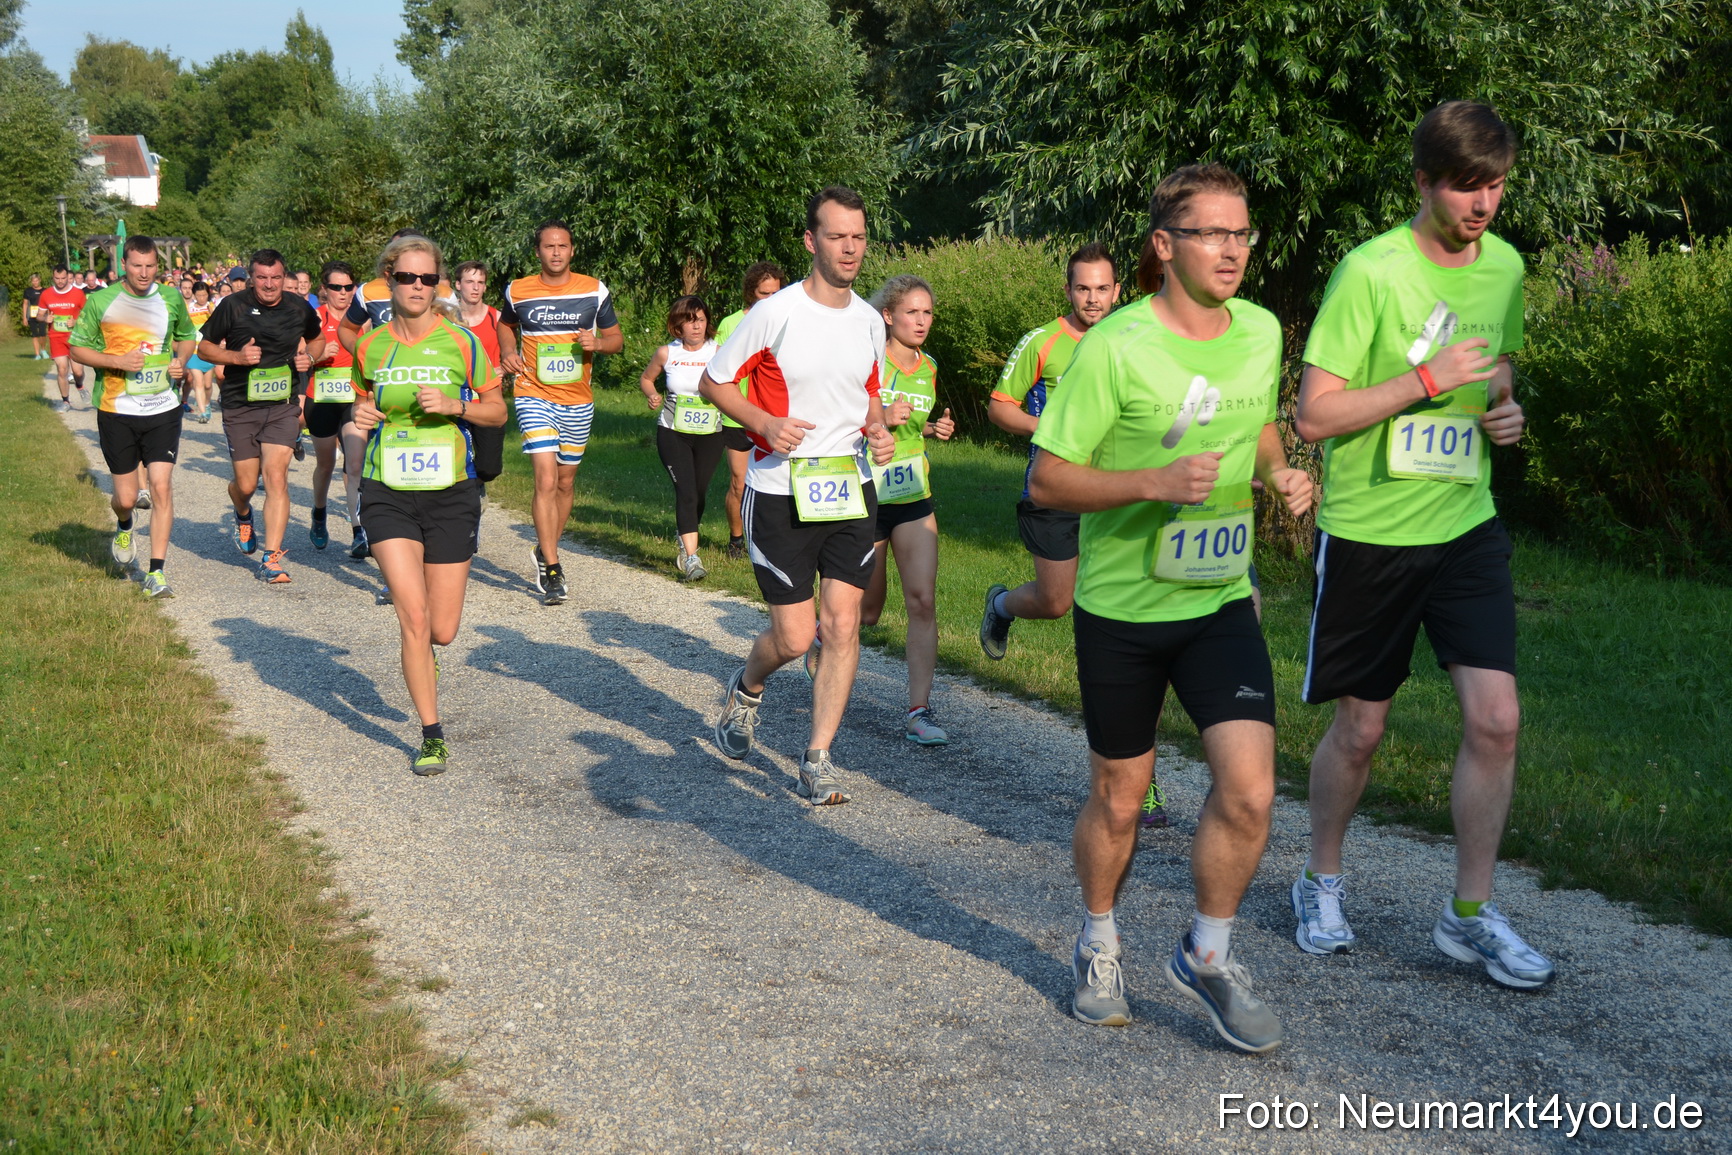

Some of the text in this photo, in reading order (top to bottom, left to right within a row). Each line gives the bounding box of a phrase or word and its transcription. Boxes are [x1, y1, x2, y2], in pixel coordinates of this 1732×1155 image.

[537, 311, 581, 321] Fischer
[547, 360, 575, 373] 409
[135, 370, 162, 384] 987
[373, 366, 452, 385] BOCK
[254, 380, 287, 393] 1206
[319, 382, 351, 393] 1396
[1153, 393, 1269, 415] PORTFORMANC
[684, 411, 709, 424] 582
[1200, 439, 1227, 449] Secure
[1401, 422, 1473, 456] 1101
[397, 452, 440, 472] 154
[883, 464, 913, 487] 151
[809, 480, 849, 503] 824
[1170, 523, 1247, 559] 1100
